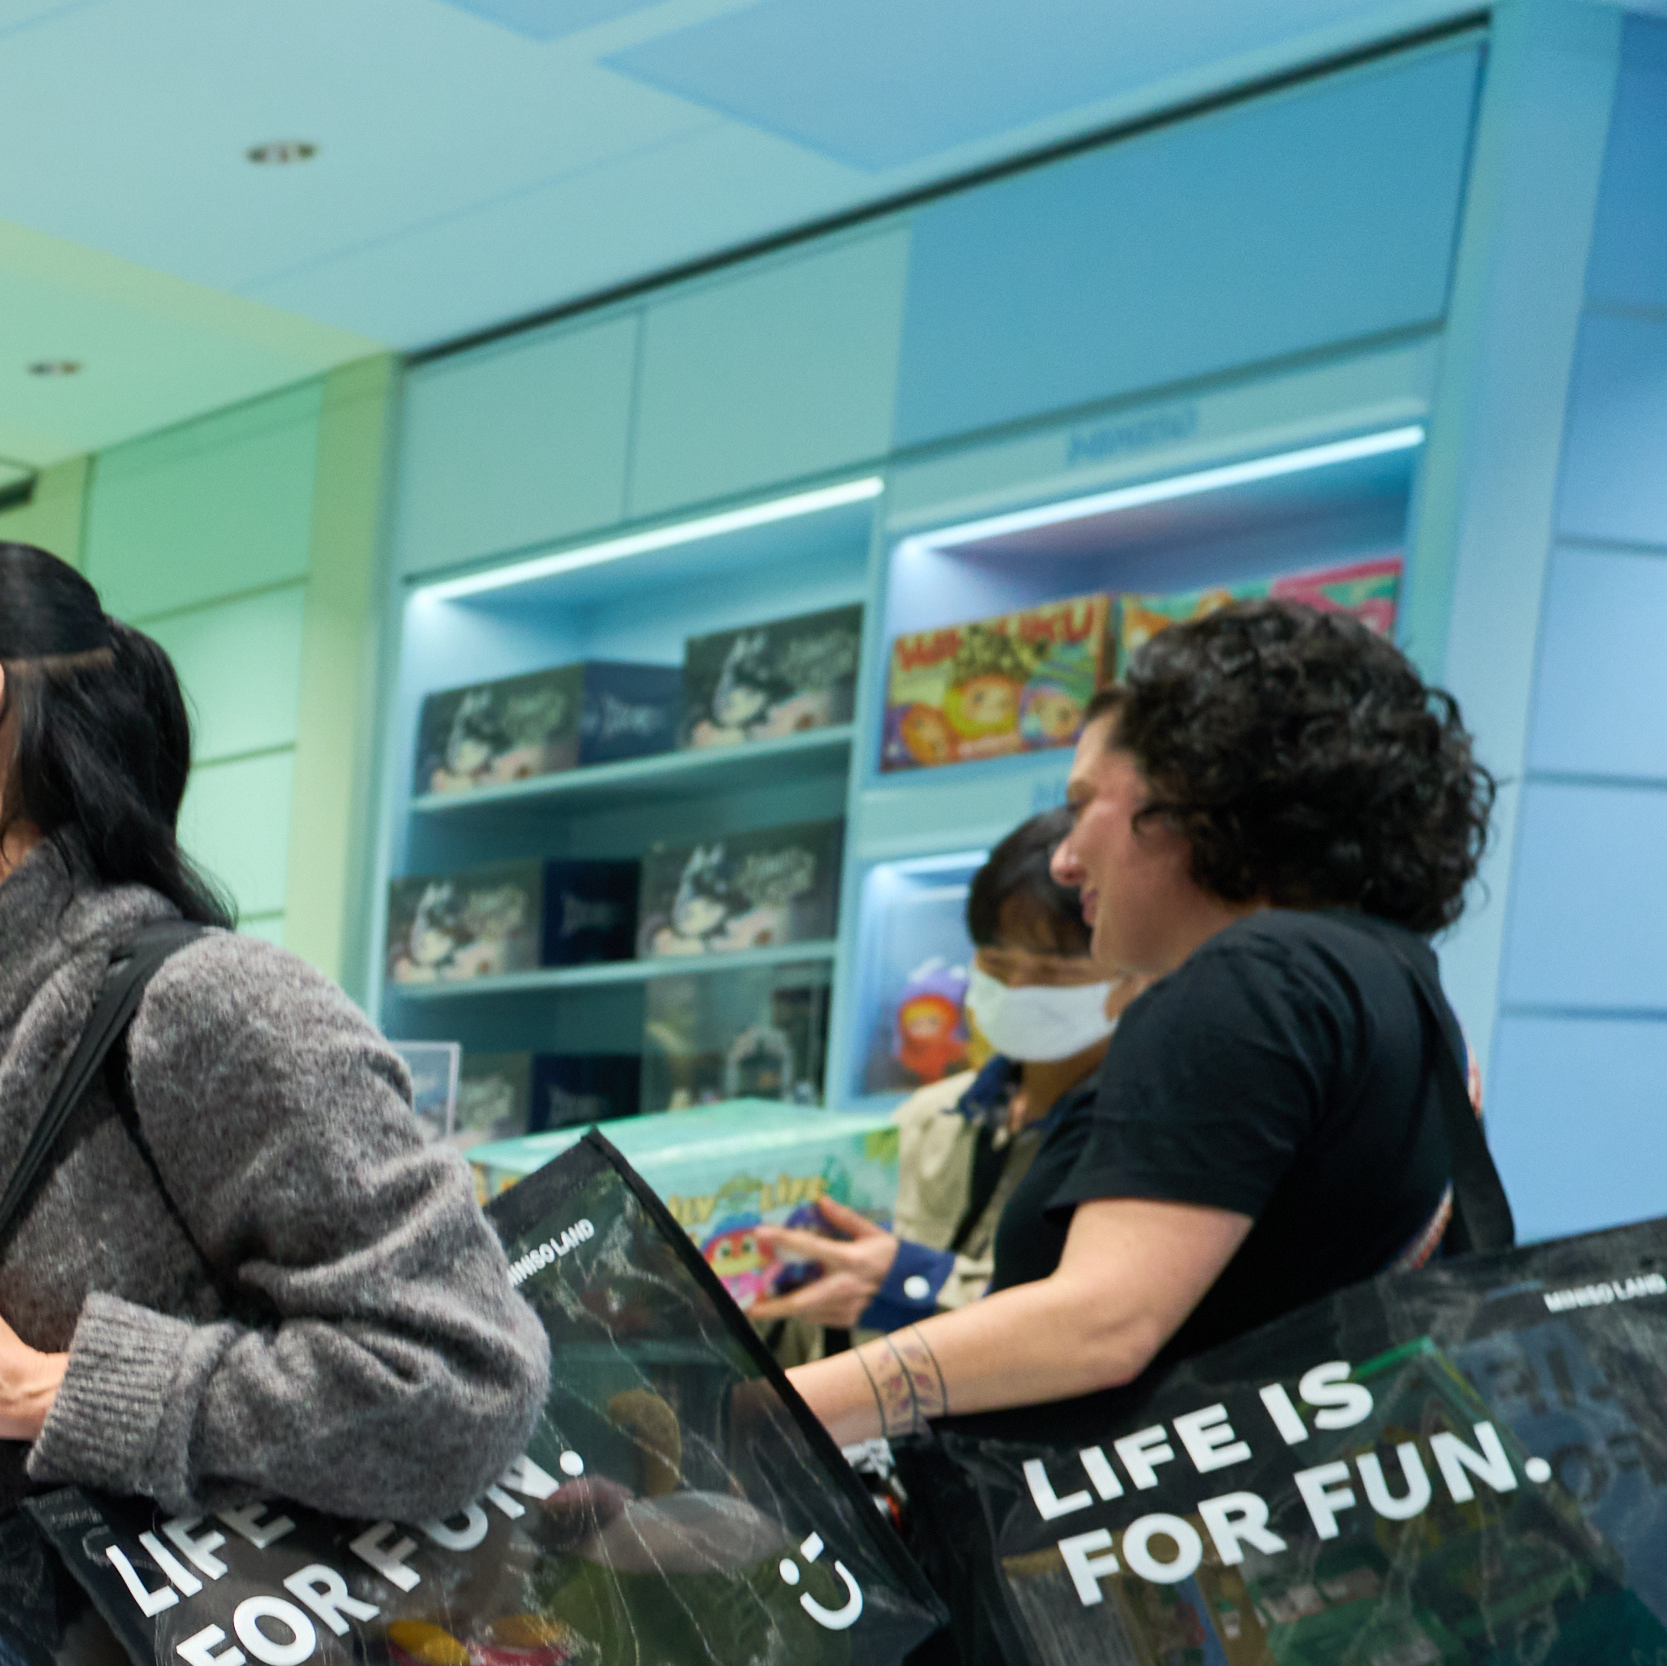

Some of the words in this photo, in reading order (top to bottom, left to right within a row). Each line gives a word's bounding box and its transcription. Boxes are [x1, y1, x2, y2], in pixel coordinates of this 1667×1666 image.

[550, 1219, 595, 1257] LAND
[1612, 1272, 1667, 1300] LAND
[1022, 1403, 1252, 1521] LIFE
[1259, 1361, 1374, 1445] IS
[105, 1500, 297, 1618] LIFE
[1058, 1491, 1287, 1606] FOR
[1293, 1422, 1553, 1540] FUN.
